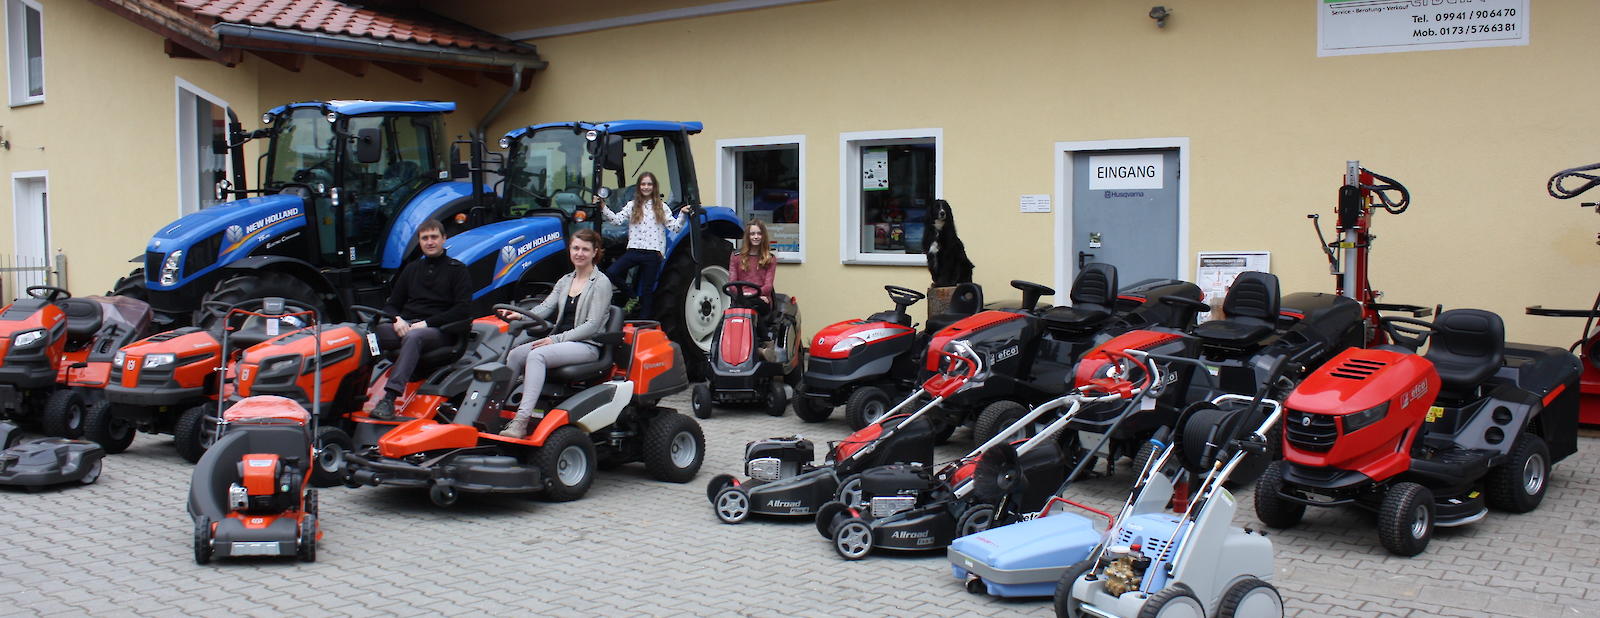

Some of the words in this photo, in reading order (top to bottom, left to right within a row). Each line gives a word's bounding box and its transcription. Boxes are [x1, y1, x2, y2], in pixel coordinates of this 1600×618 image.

[1356, 6, 1382, 14] Beratung
[1386, 4, 1409, 12] Verkauf
[1412, 14, 1429, 23] Tel.
[1413, 28, 1438, 37] Mob.
[1097, 165, 1155, 179] EINGANG
[1111, 191, 1144, 199] Husqvarna
[246, 218, 265, 234] NEW
[264, 207, 299, 225] HOLLAND
[517, 241, 533, 256] NEW
[532, 231, 560, 248] HOLLAND
[998, 347, 1017, 359] efco
[766, 499, 802, 508] Allroad
[891, 530, 929, 539] Allroad
